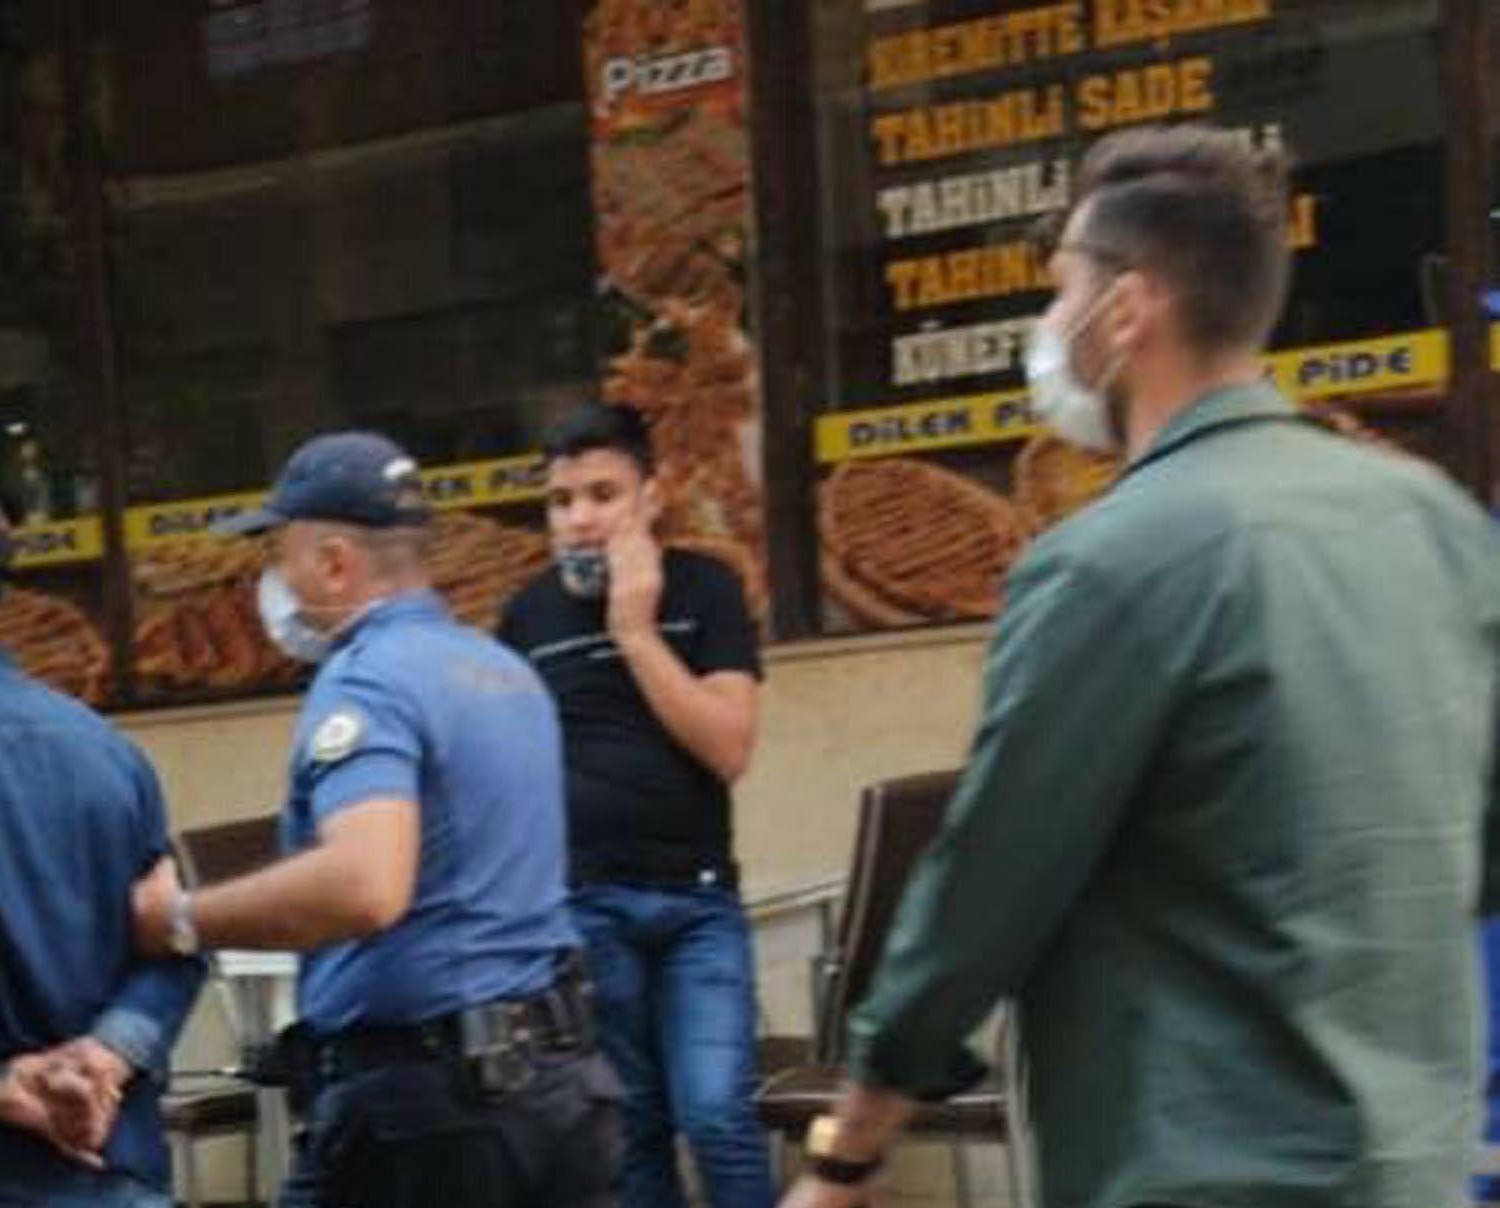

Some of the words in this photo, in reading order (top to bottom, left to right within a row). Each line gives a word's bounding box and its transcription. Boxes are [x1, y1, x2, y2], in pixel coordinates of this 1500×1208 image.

[597, 47, 731, 118] Pizza
[1077, 56, 1215, 130] SADE
[1299, 346, 1411, 386] PİDE
[849, 408, 969, 446] DİLEK
